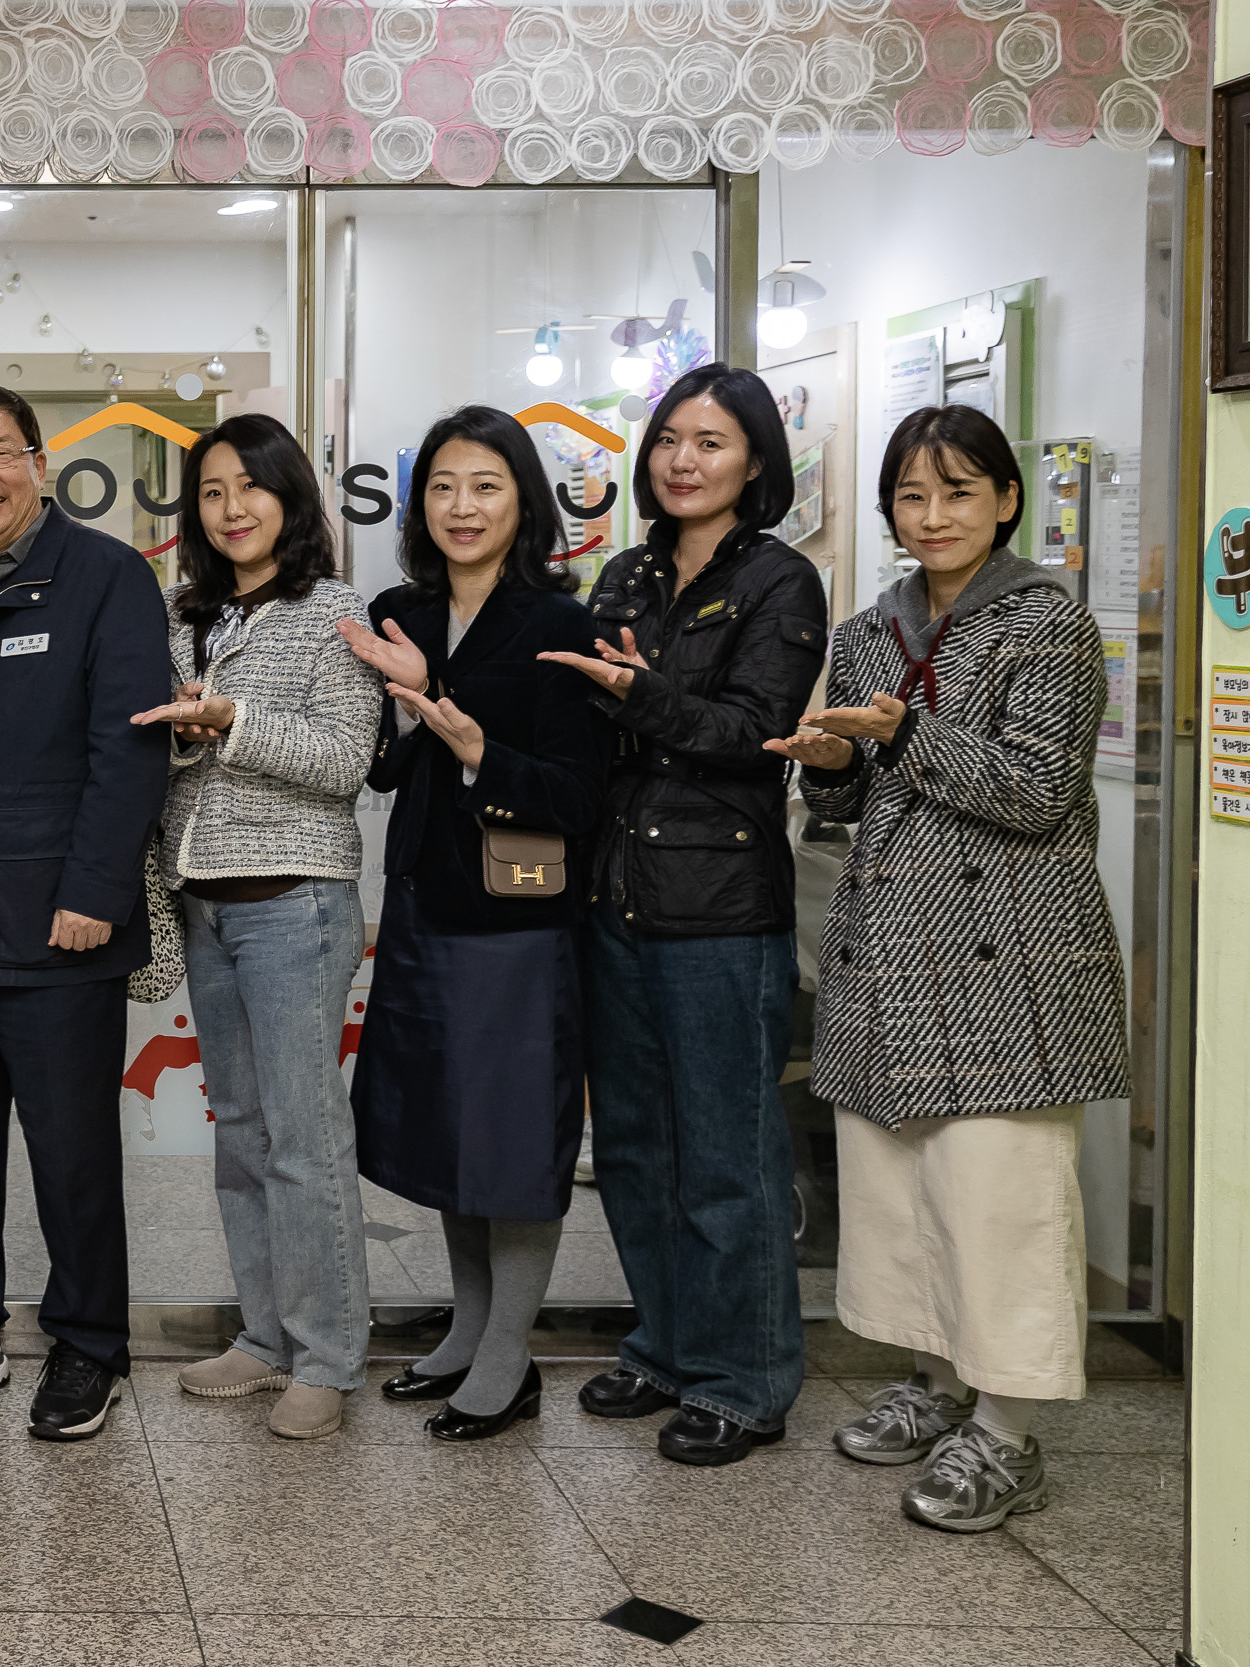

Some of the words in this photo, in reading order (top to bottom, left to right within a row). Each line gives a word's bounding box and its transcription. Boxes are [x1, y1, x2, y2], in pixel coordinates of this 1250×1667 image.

[1080, 447, 1088, 459] 9
[1068, 552, 1078, 565] 2
[1223, 678, 1249, 692] 부모님의
[1223, 709, 1238, 722] 잠시
[1222, 768, 1235, 782] 책은
[1222, 797, 1241, 813] 물건은
